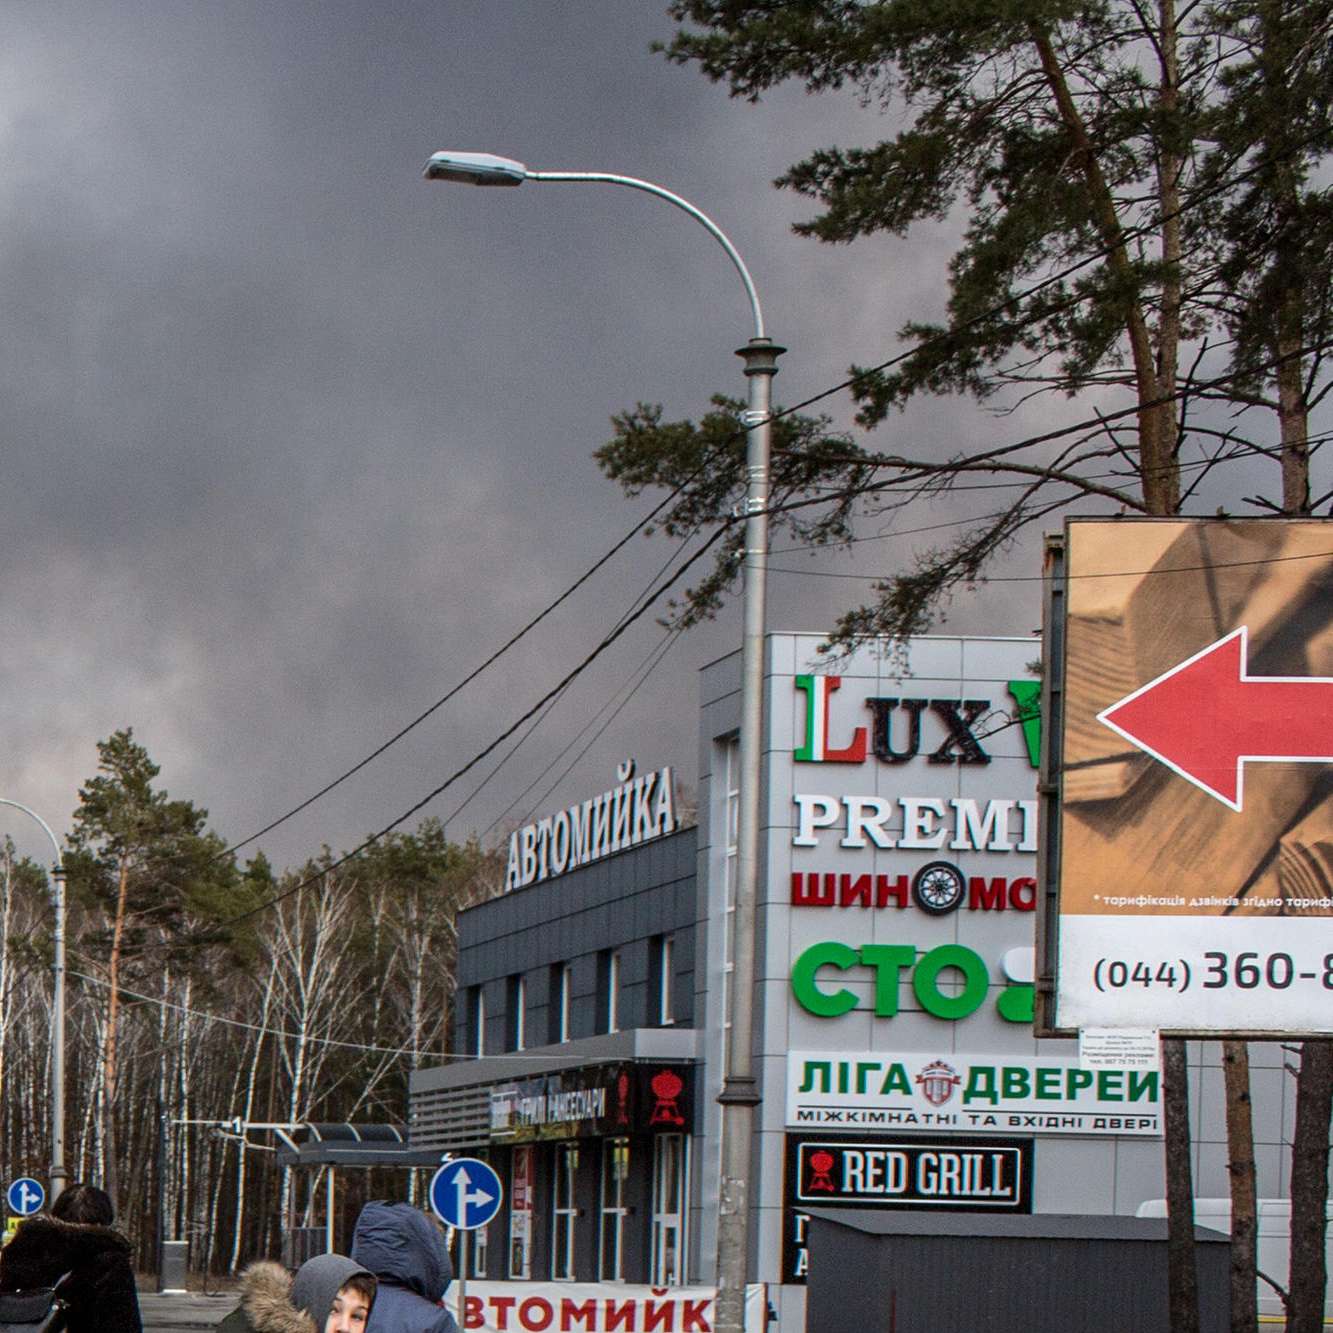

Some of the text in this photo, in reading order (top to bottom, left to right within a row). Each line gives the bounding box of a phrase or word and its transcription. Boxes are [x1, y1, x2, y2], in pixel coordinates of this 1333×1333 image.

[794, 675, 992, 764] LUX
[505, 759, 677, 892] АВТОМИЙКА
[1103, 895, 1186, 908] тарифікація
[1189, 896, 1239, 908] дзвінків
[1243, 896, 1283, 908] згідно
[791, 941, 990, 1020] СТО
[1094, 958, 1191, 993] (044)
[797, 1061, 914, 1096] ЛІГА
[797, 1111, 1157, 1131] МІЖКІМНАТНІ ТА ВХІДНІ ДВЕРІ
[842, 1150, 1012, 1196] RED GRILL
